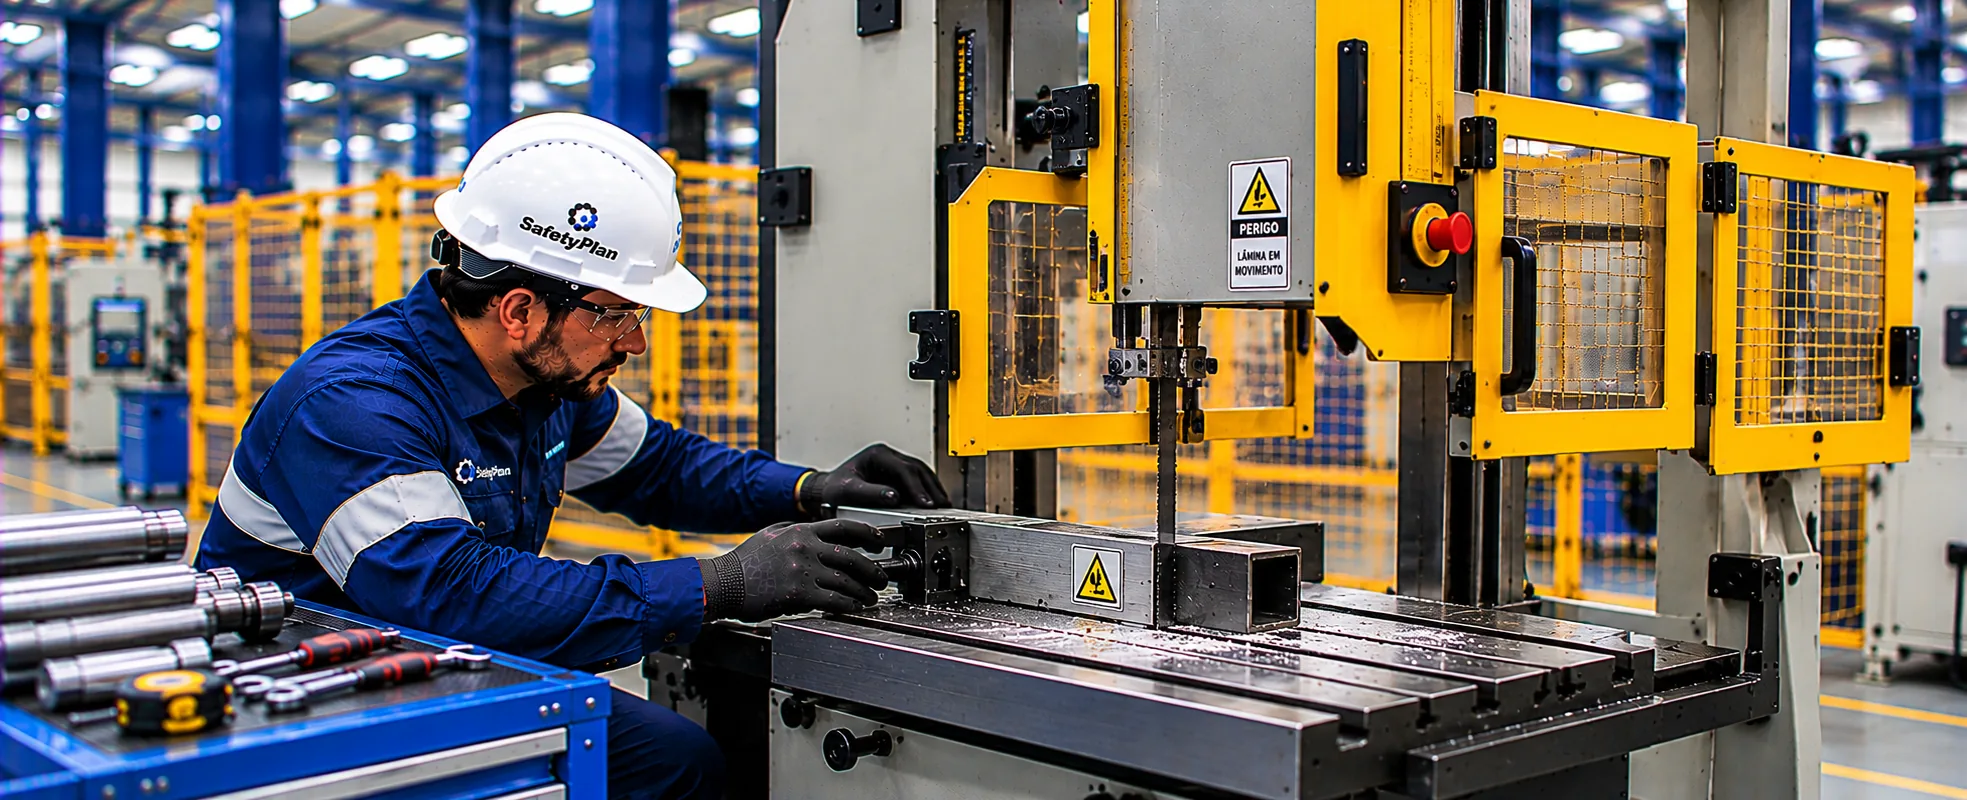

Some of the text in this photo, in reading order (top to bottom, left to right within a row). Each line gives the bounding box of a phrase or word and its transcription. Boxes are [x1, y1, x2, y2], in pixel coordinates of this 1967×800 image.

[1239, 221, 1279, 235] PERIGO
[519, 216, 619, 261] SafetyPlan
[1268, 250, 1281, 261] EM
[1235, 264, 1284, 276] MOVIMENTO
